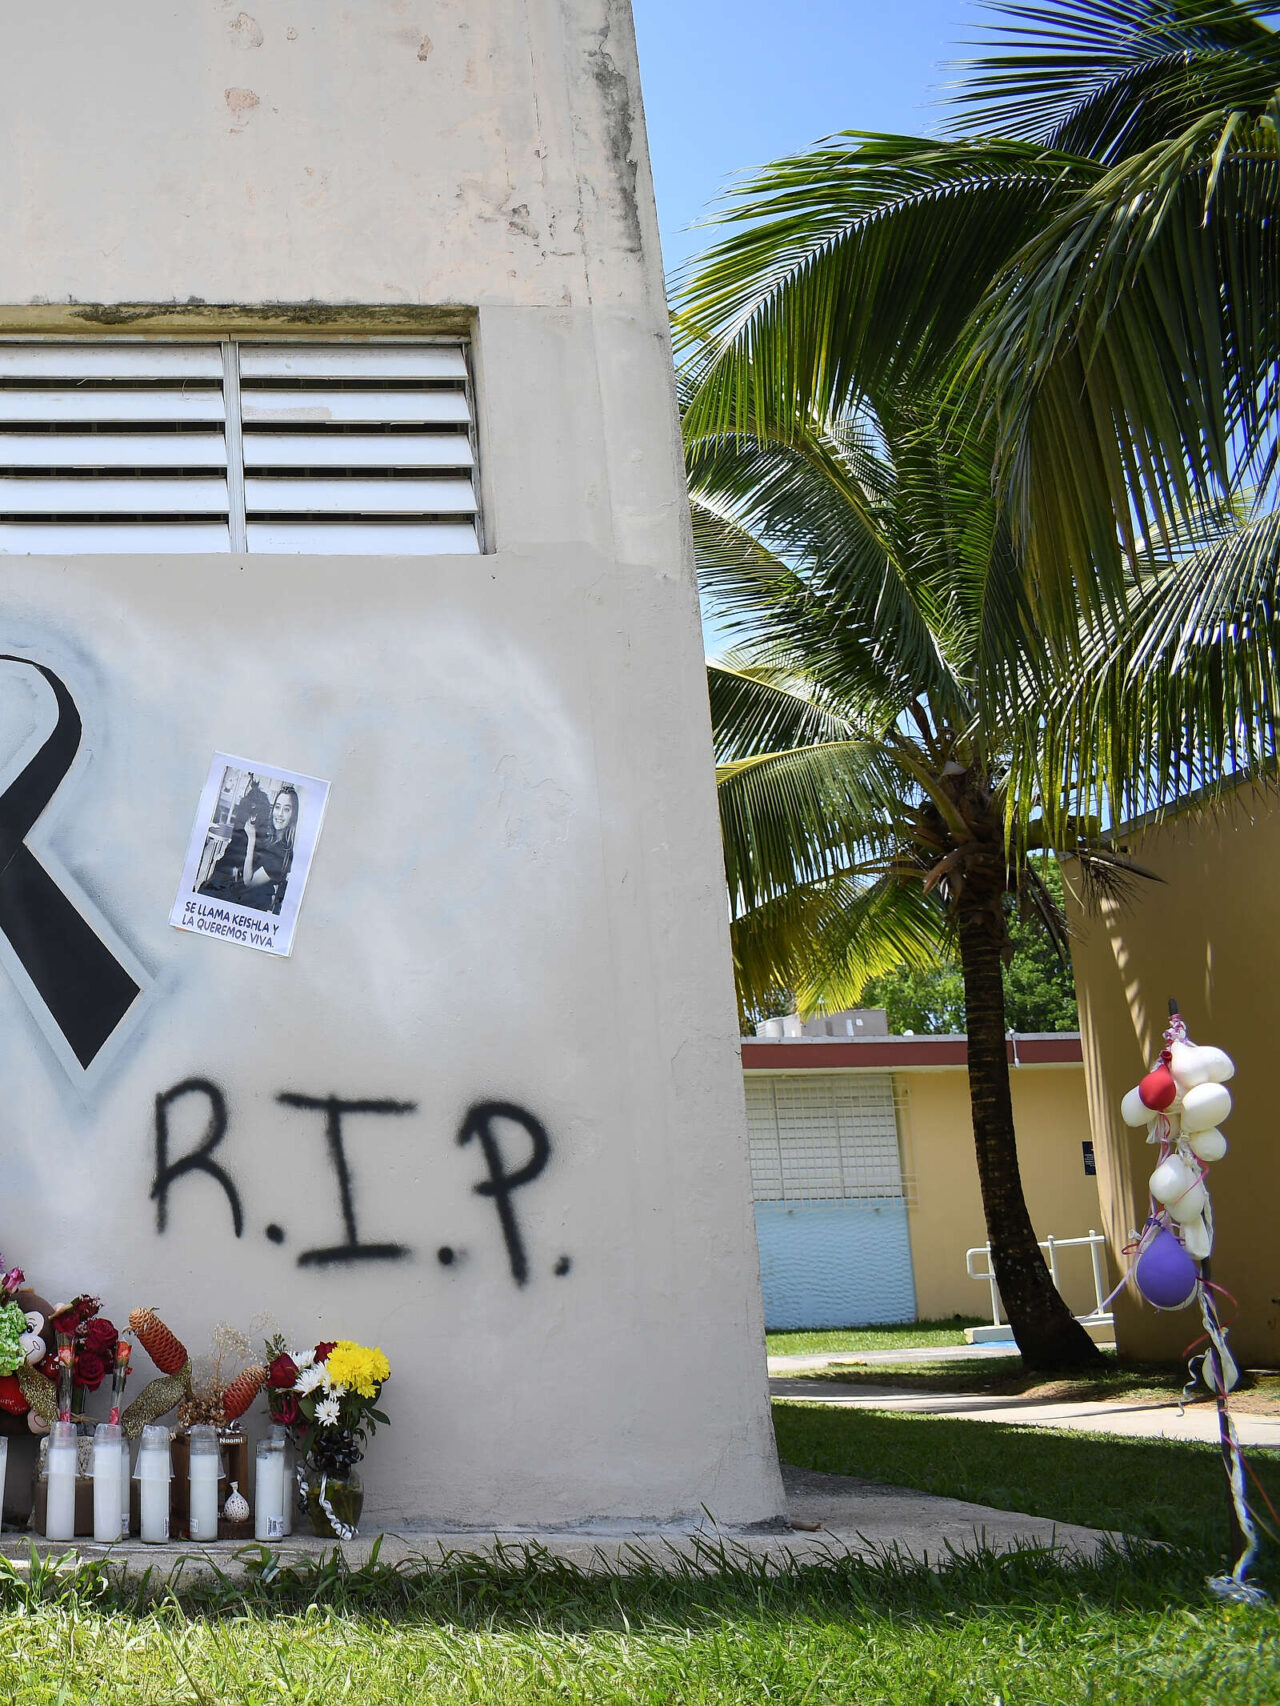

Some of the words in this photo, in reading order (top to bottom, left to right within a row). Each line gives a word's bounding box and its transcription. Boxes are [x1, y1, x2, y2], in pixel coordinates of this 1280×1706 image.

[182, 914, 194, 926] LA
[196, 918, 247, 941] QUEREMOS
[250, 932, 274, 948] VIVA.
[185, 901, 196, 913] SE
[197, 903, 230, 922] LLAMA
[231, 914, 269, 933] KEISHLA
[273, 924, 279, 935] Y
